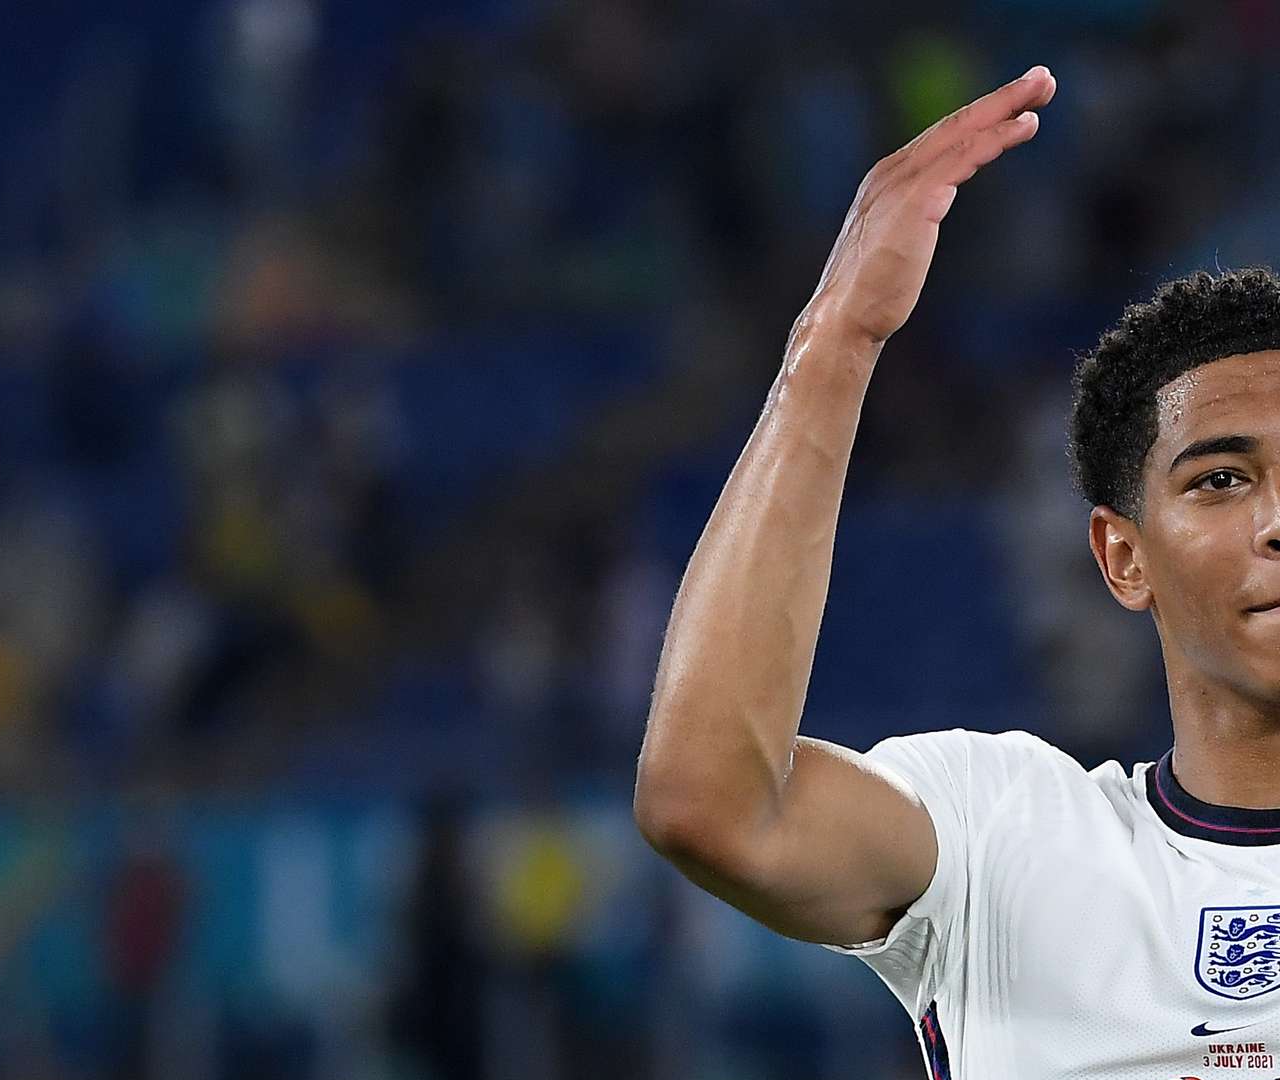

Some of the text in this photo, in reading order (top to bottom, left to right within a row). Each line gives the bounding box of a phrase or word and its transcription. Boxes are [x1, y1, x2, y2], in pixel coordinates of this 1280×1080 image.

[1208, 1042, 1267, 1055] UKRAINE
[1202, 1054, 1274, 1069] 3 JULY 2021
